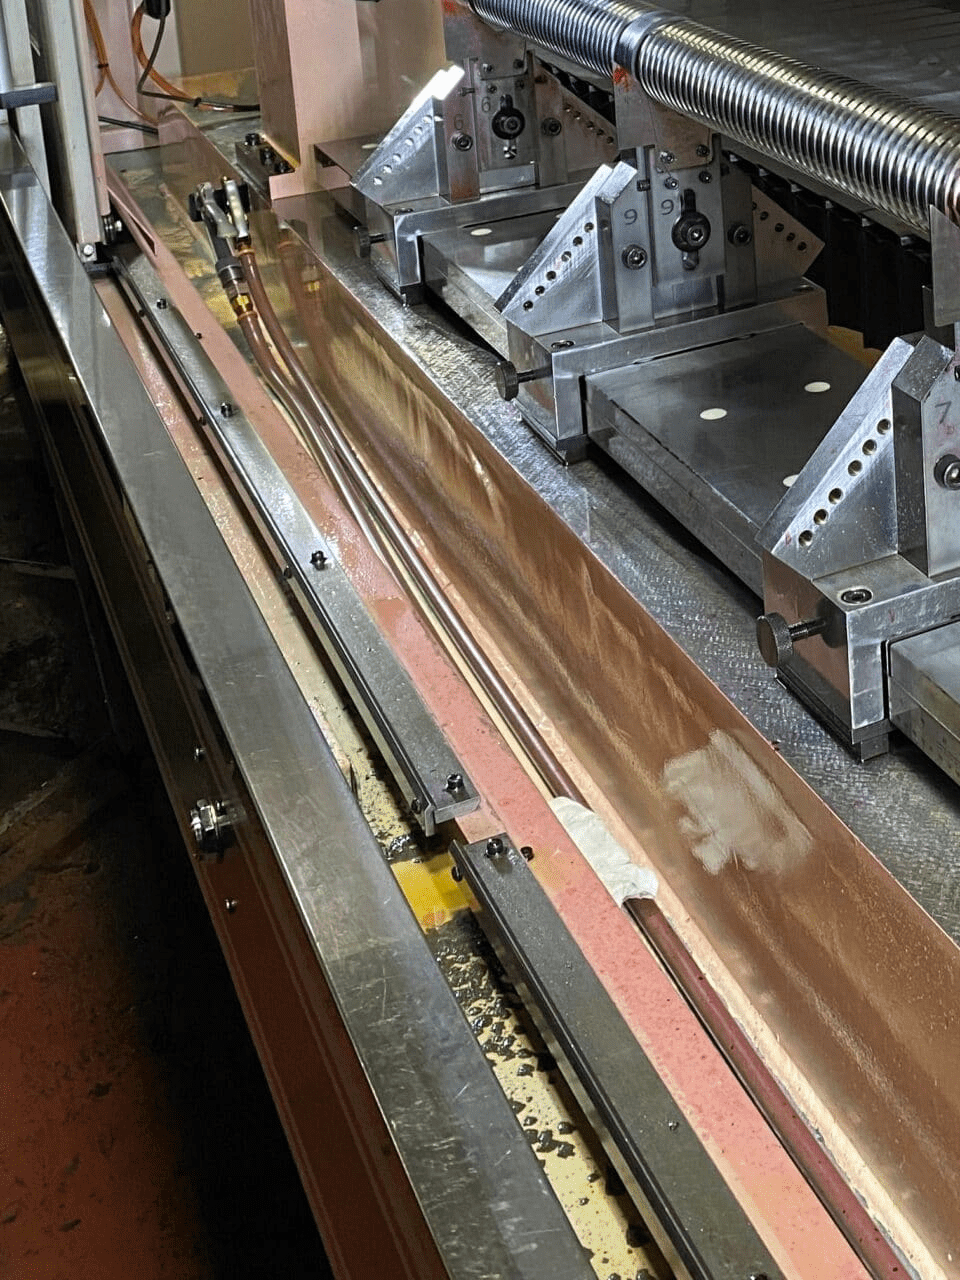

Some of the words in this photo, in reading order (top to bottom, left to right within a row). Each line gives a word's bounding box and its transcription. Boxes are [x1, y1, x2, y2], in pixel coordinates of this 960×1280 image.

[481, 96, 491, 113] 6
[453, 113, 464, 130] 6
[660, 198, 675, 216] 9
[623, 208, 638, 226] 9
[934, 400, 952, 424] 7
